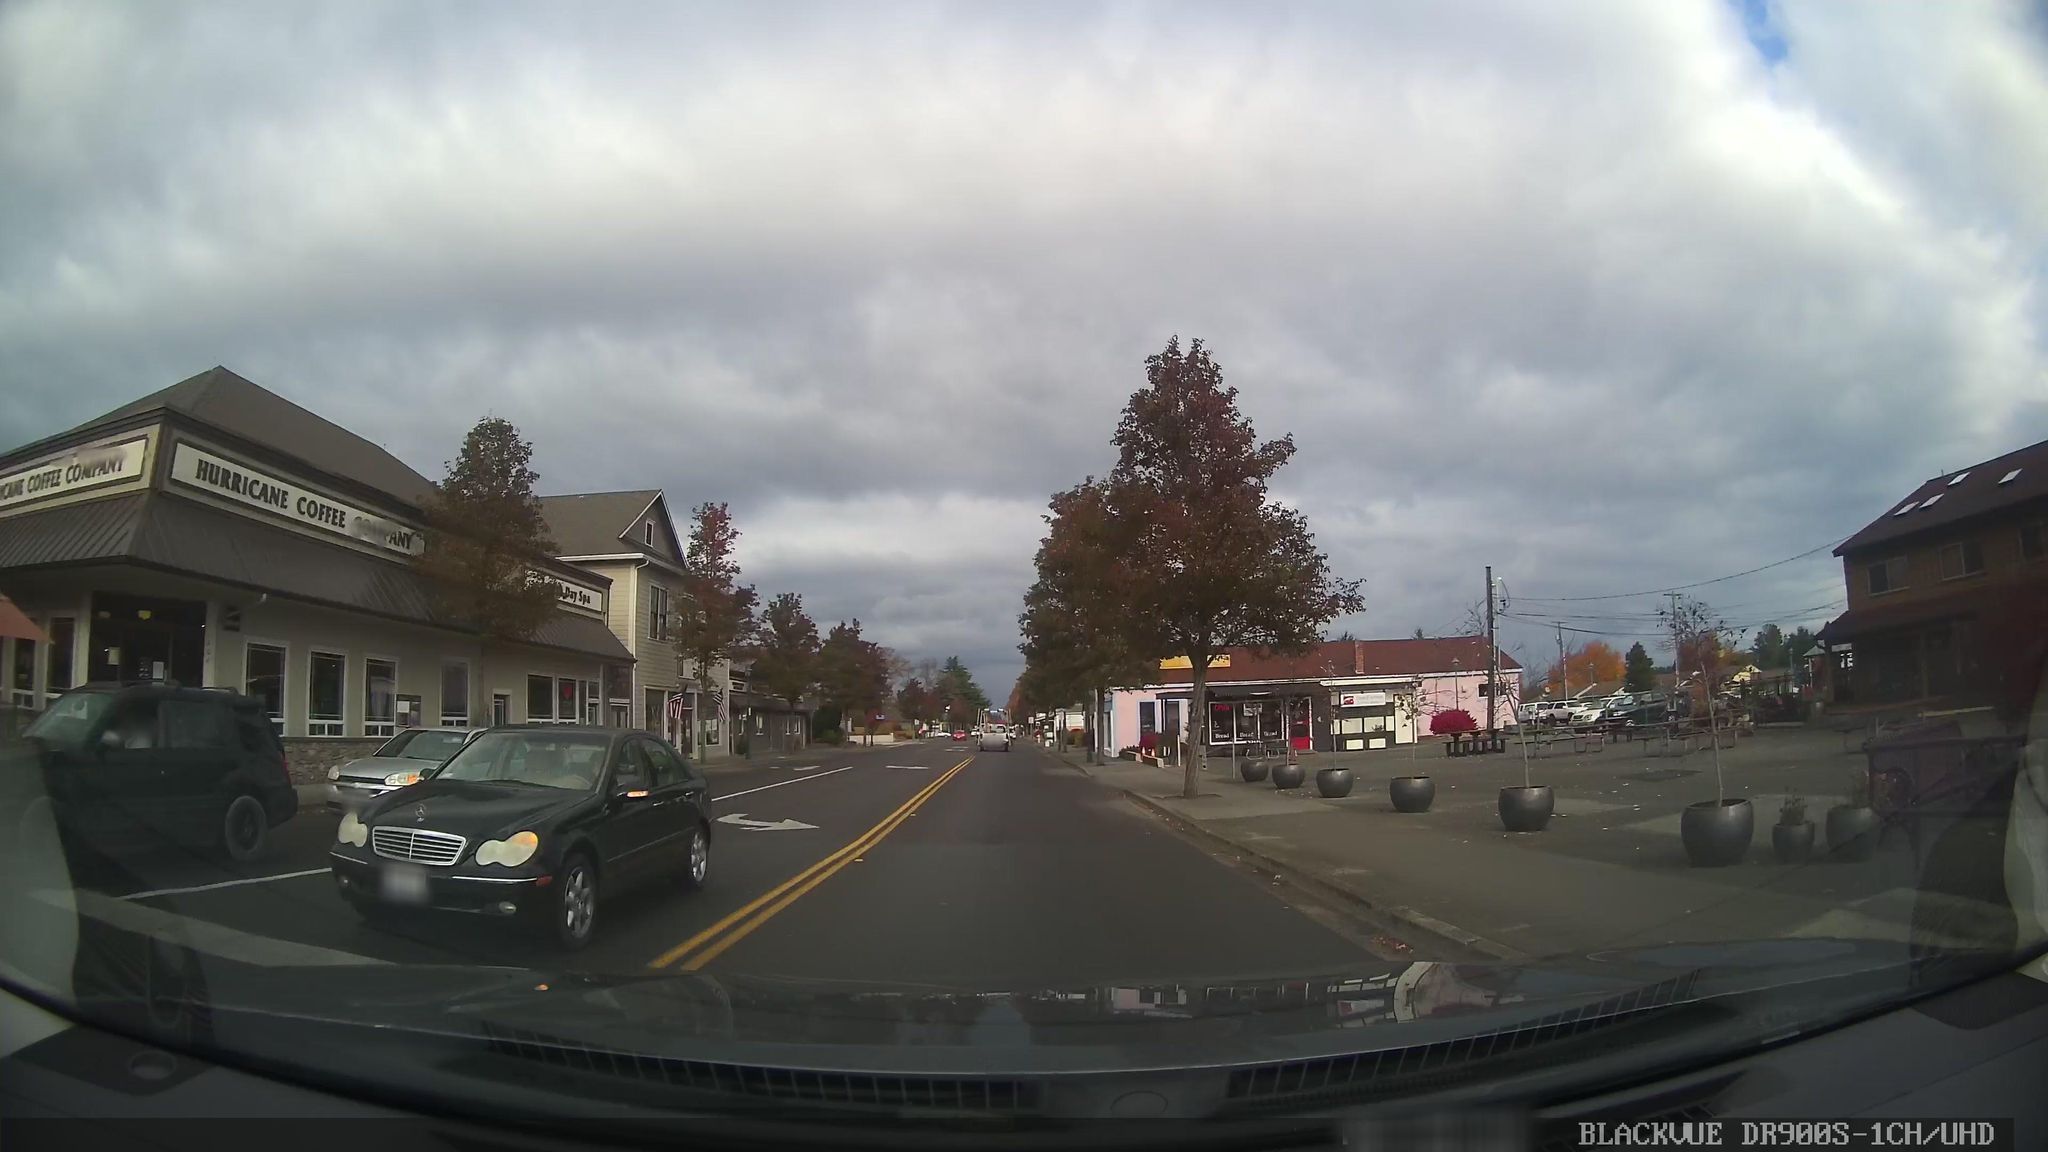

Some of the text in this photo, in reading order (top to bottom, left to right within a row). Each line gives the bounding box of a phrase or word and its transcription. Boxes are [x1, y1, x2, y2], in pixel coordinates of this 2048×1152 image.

[27, 468, 62, 493] COFFEE
[195, 458, 289, 510] HURRICANE
[296, 496, 347, 529] COFFEE
[579, 590, 591, 605] Spa
